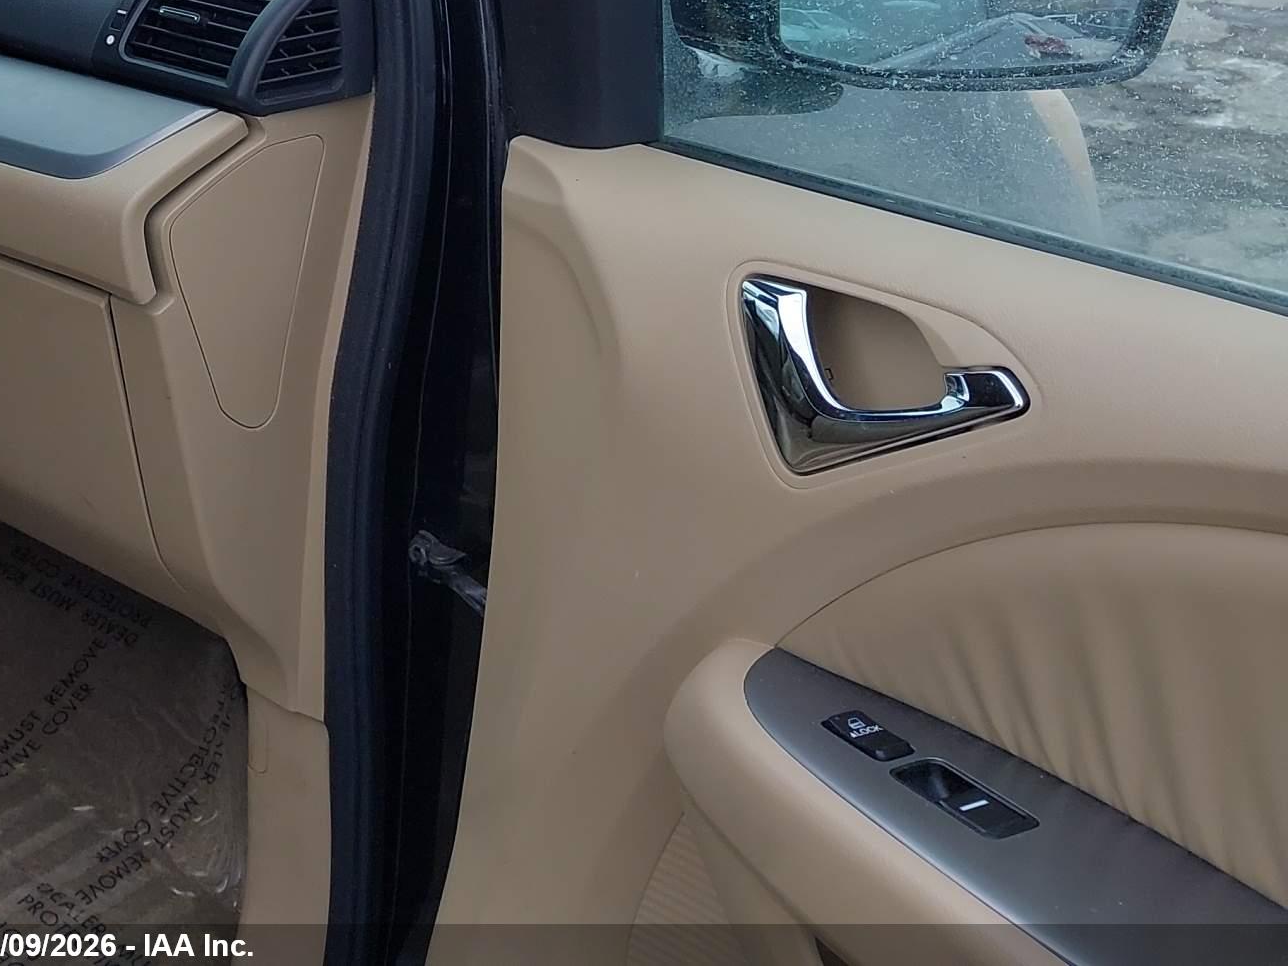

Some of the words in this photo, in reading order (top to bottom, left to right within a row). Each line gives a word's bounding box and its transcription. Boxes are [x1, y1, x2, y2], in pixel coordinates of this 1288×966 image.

[43, 637, 108, 706] REMOVE
[41, 682, 97, 736] COVER
[851, 724, 884, 738] LOCK
[95, 818, 152, 864] COVER
[152, 793, 202, 851] MUST
